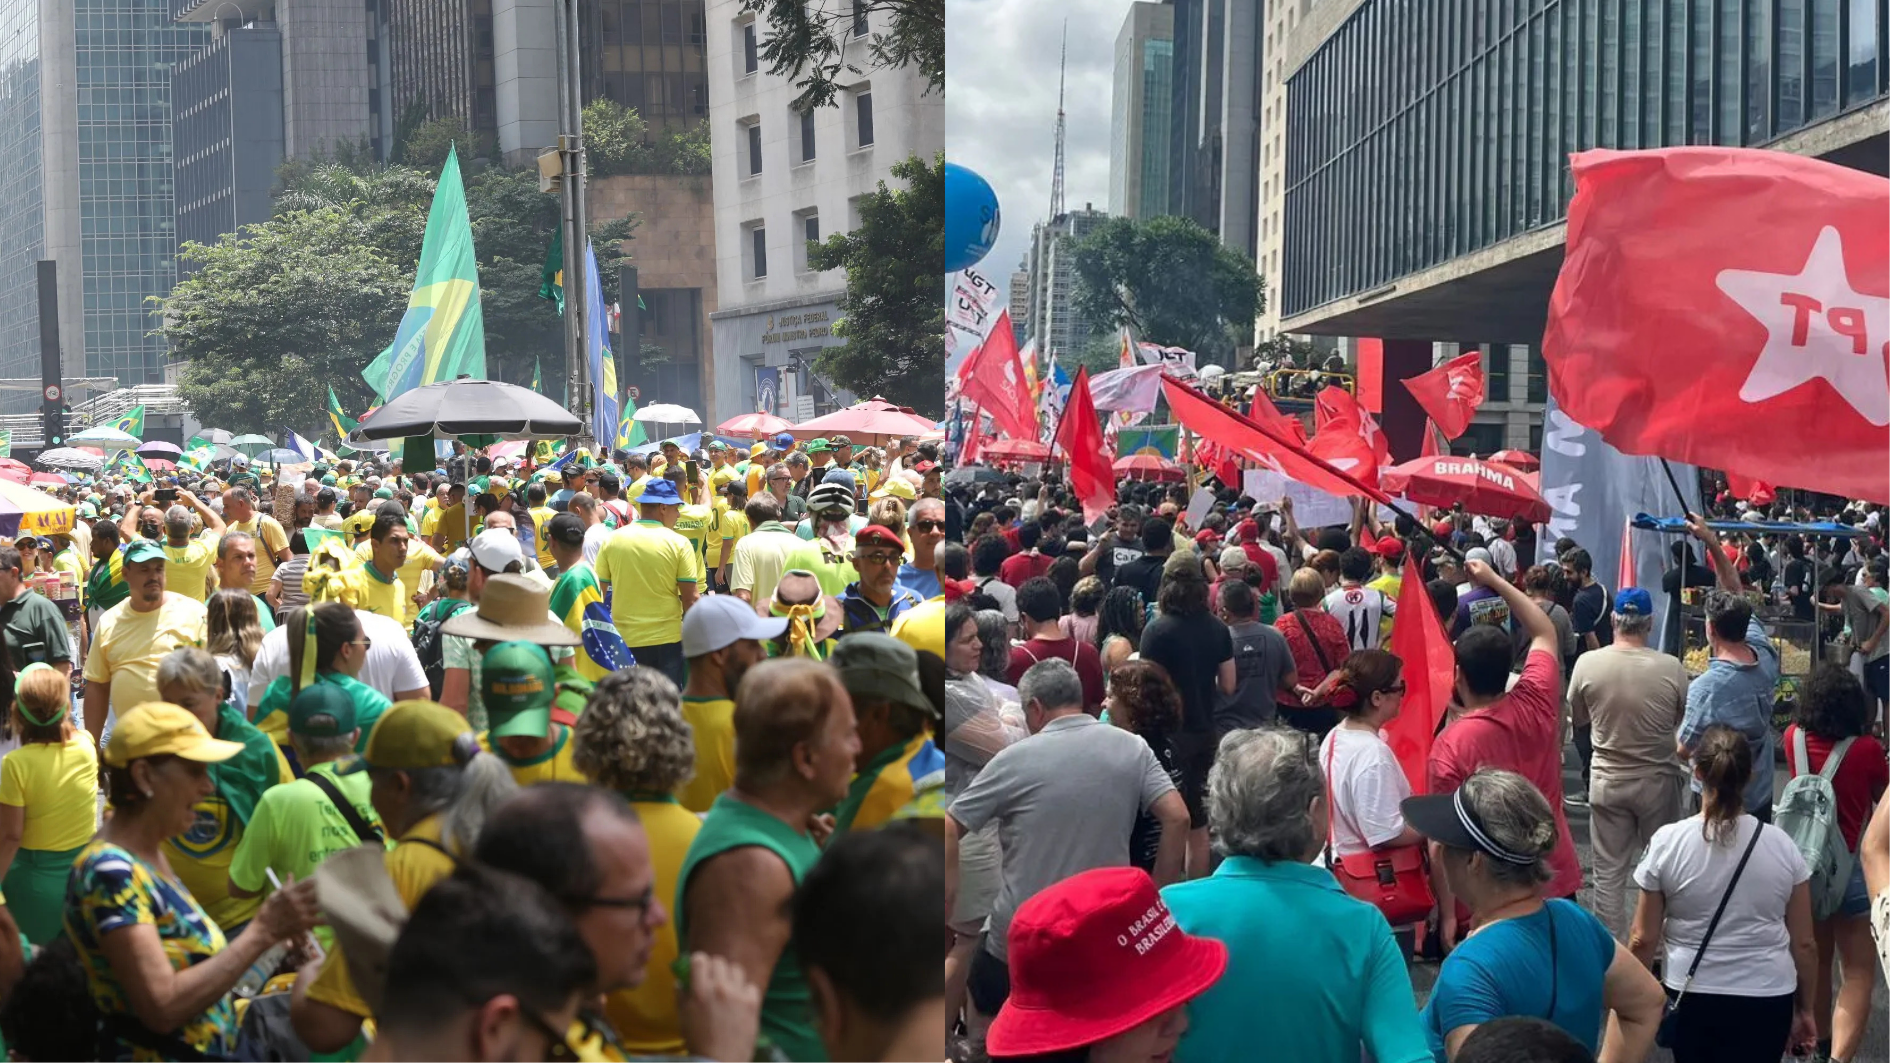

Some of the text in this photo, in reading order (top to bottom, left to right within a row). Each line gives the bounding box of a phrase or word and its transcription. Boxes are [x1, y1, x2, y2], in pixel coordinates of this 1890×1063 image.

[803, 311, 829, 324] FEDERAL
[809, 326, 828, 338] PEDRO
[1434, 461, 1515, 491] BRAHMA
[1117, 934, 1128, 947] O
[1128, 905, 1160, 938] BRASIL
